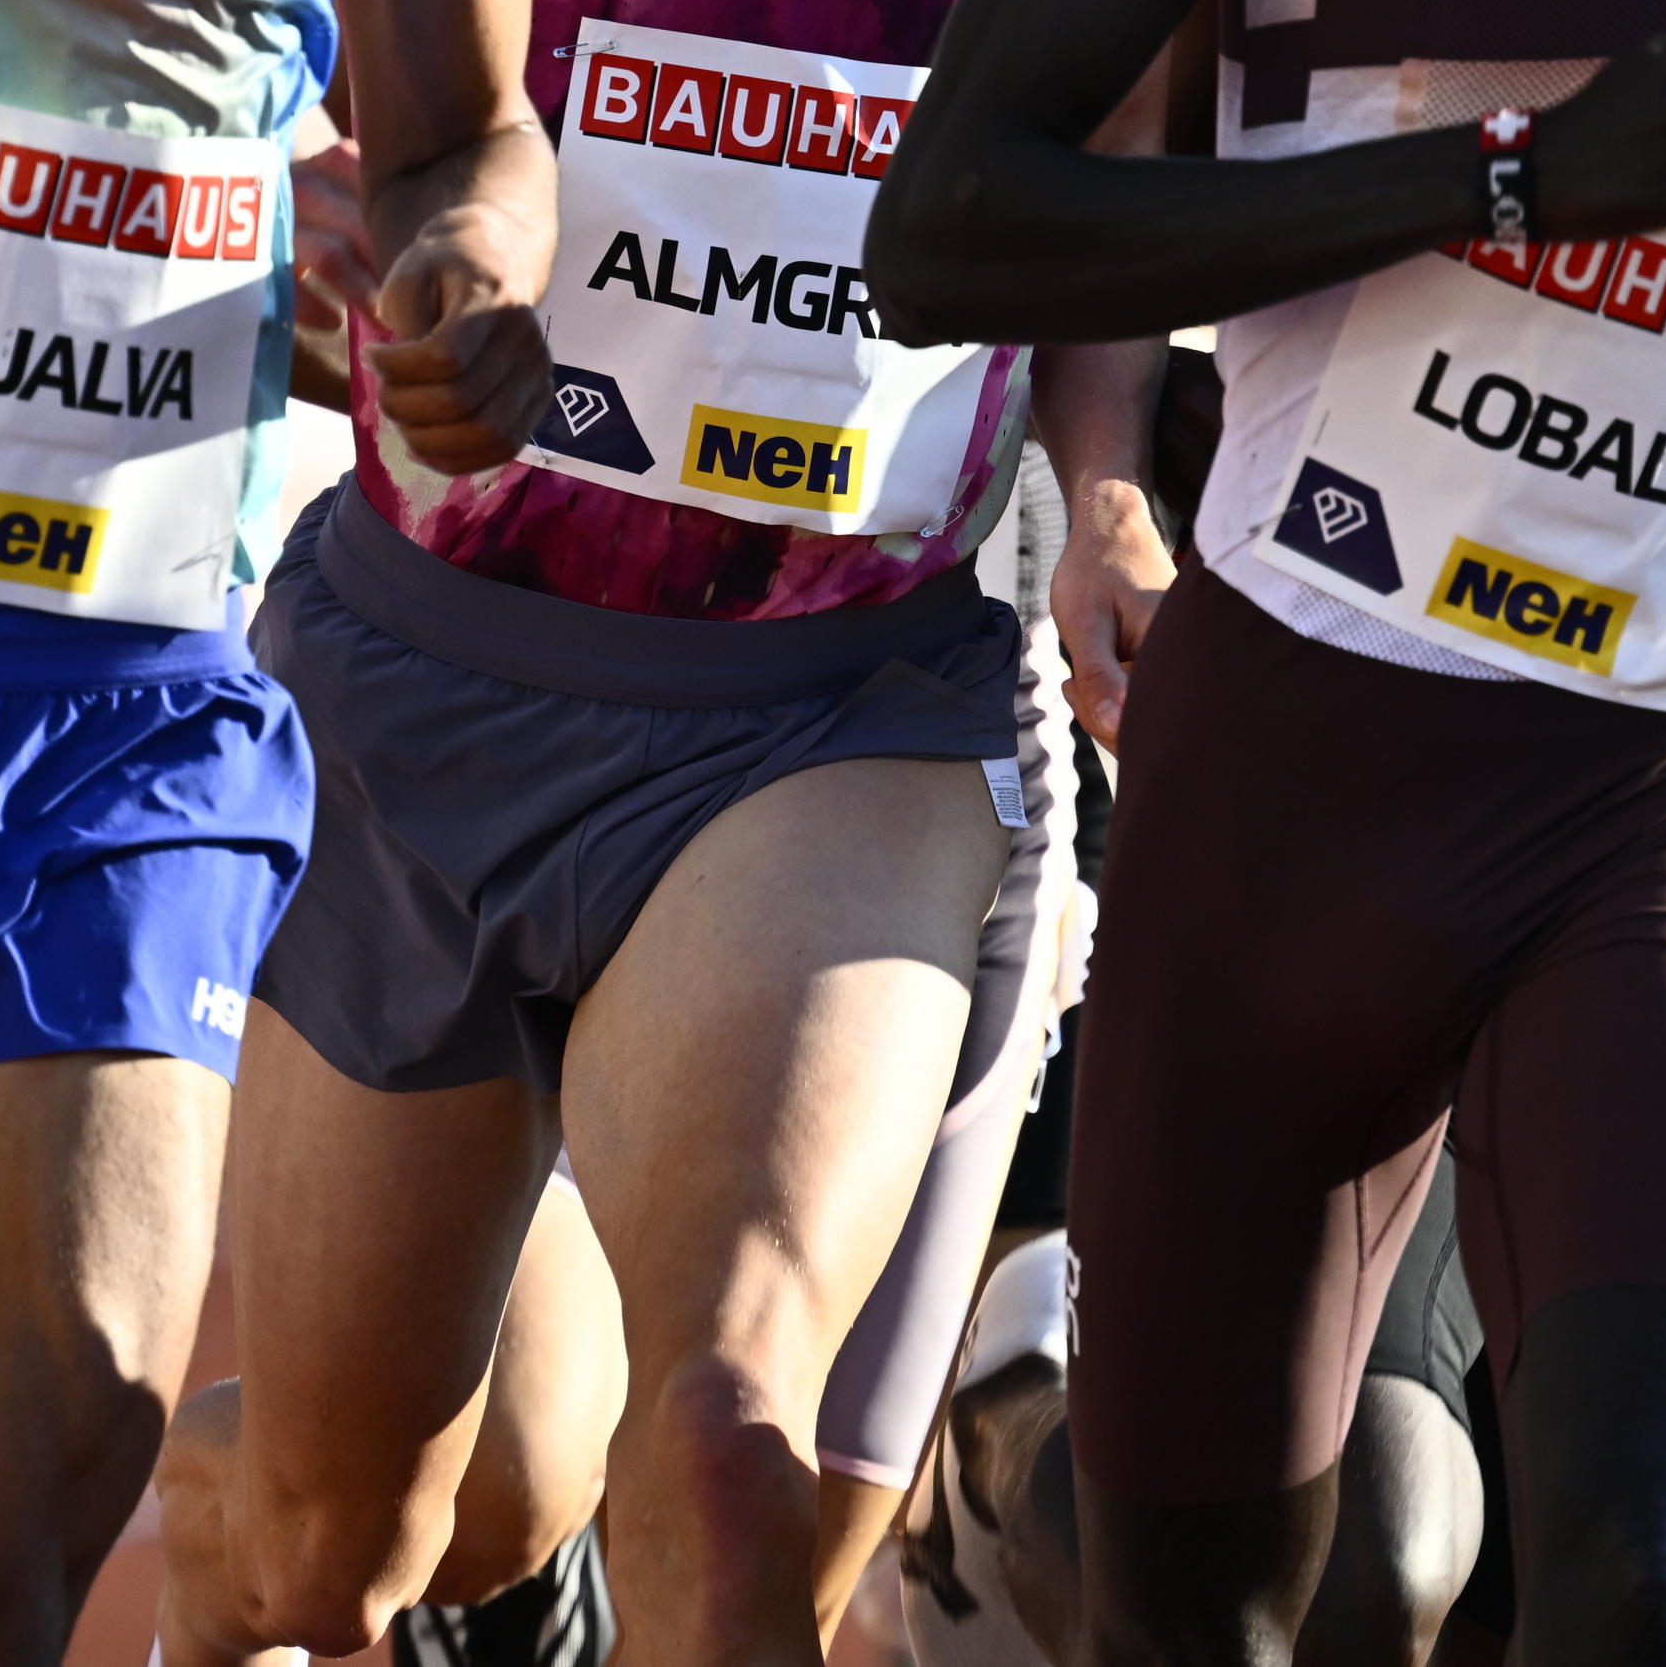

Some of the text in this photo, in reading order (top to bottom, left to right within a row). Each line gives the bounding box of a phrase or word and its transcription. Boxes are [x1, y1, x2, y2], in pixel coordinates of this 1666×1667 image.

[592, 65, 902, 159] BAUHA
[587, 230, 897, 342] ALMGR
[191, 976, 251, 1041] HO
